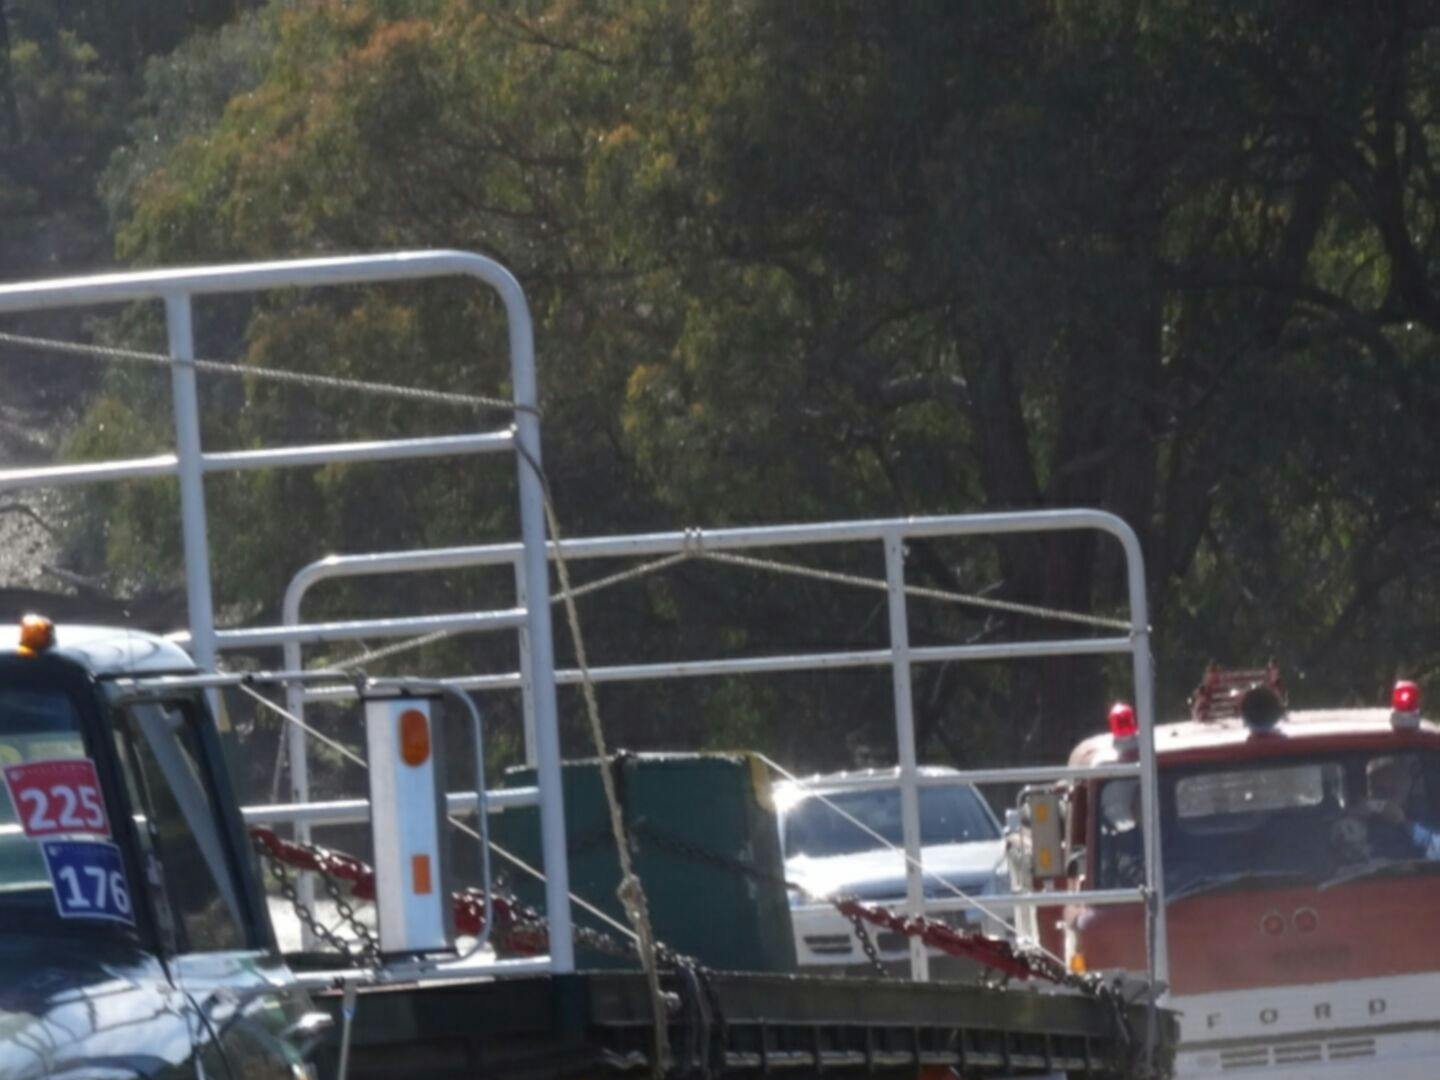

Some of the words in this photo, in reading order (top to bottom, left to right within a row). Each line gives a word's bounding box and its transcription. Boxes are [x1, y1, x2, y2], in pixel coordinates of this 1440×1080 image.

[19, 783, 105, 831] 225
[58, 865, 131, 915] 176
[1206, 997, 1388, 1029] FORD
